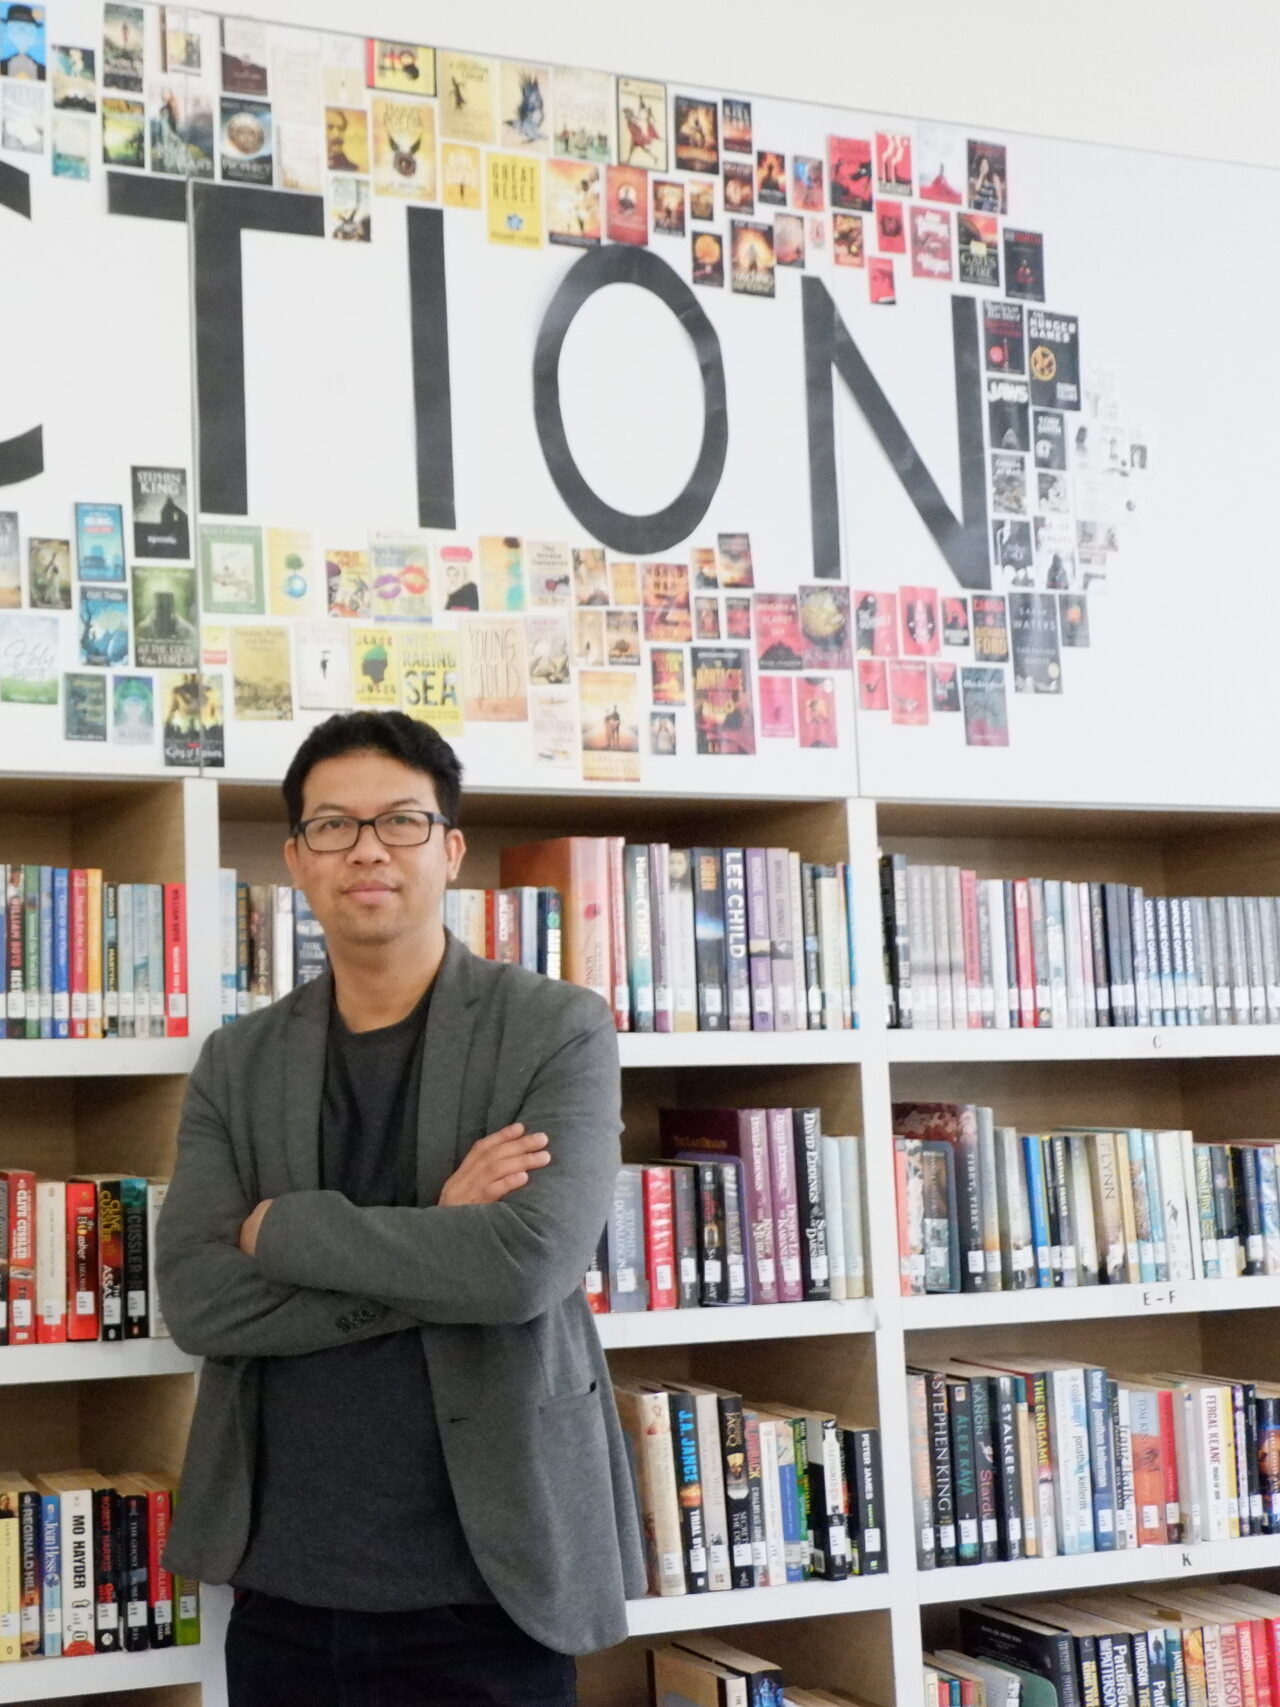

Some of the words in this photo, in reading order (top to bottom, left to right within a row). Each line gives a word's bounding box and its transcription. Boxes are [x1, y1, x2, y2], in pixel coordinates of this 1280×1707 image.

[137, 471, 181, 484] STEPHEN
[140, 484, 180, 496] KING
[402, 651, 457, 668] RAGING
[405, 671, 459, 706] SEA
[634, 856, 648, 900] Harlan
[726, 851, 743, 890] LEE
[635, 900, 651, 958] COBEN
[726, 894, 747, 959] CHILD
[15, 1189, 28, 1217] CLIVE
[99, 1190, 112, 1243] CUSSLER
[109, 1199, 122, 1233] CLIVE
[15, 1218, 28, 1260] CUSSLER
[1033, 1379, 1045, 1402] THE
[930, 1374, 950, 1458] STEPHEN
[955, 1414, 971, 1456] ALEX
[1000, 1402, 1016, 1476] STALKER
[680, 1440, 698, 1483] JANCE
[957, 1456, 974, 1497] KAVA
[934, 1461, 953, 1514] KING
[22, 1508, 34, 1567] REGINALD
[72, 1514, 85, 1535] MO
[71, 1540, 87, 1590] HAYDER
[1181, 1553, 1193, 1567] K
